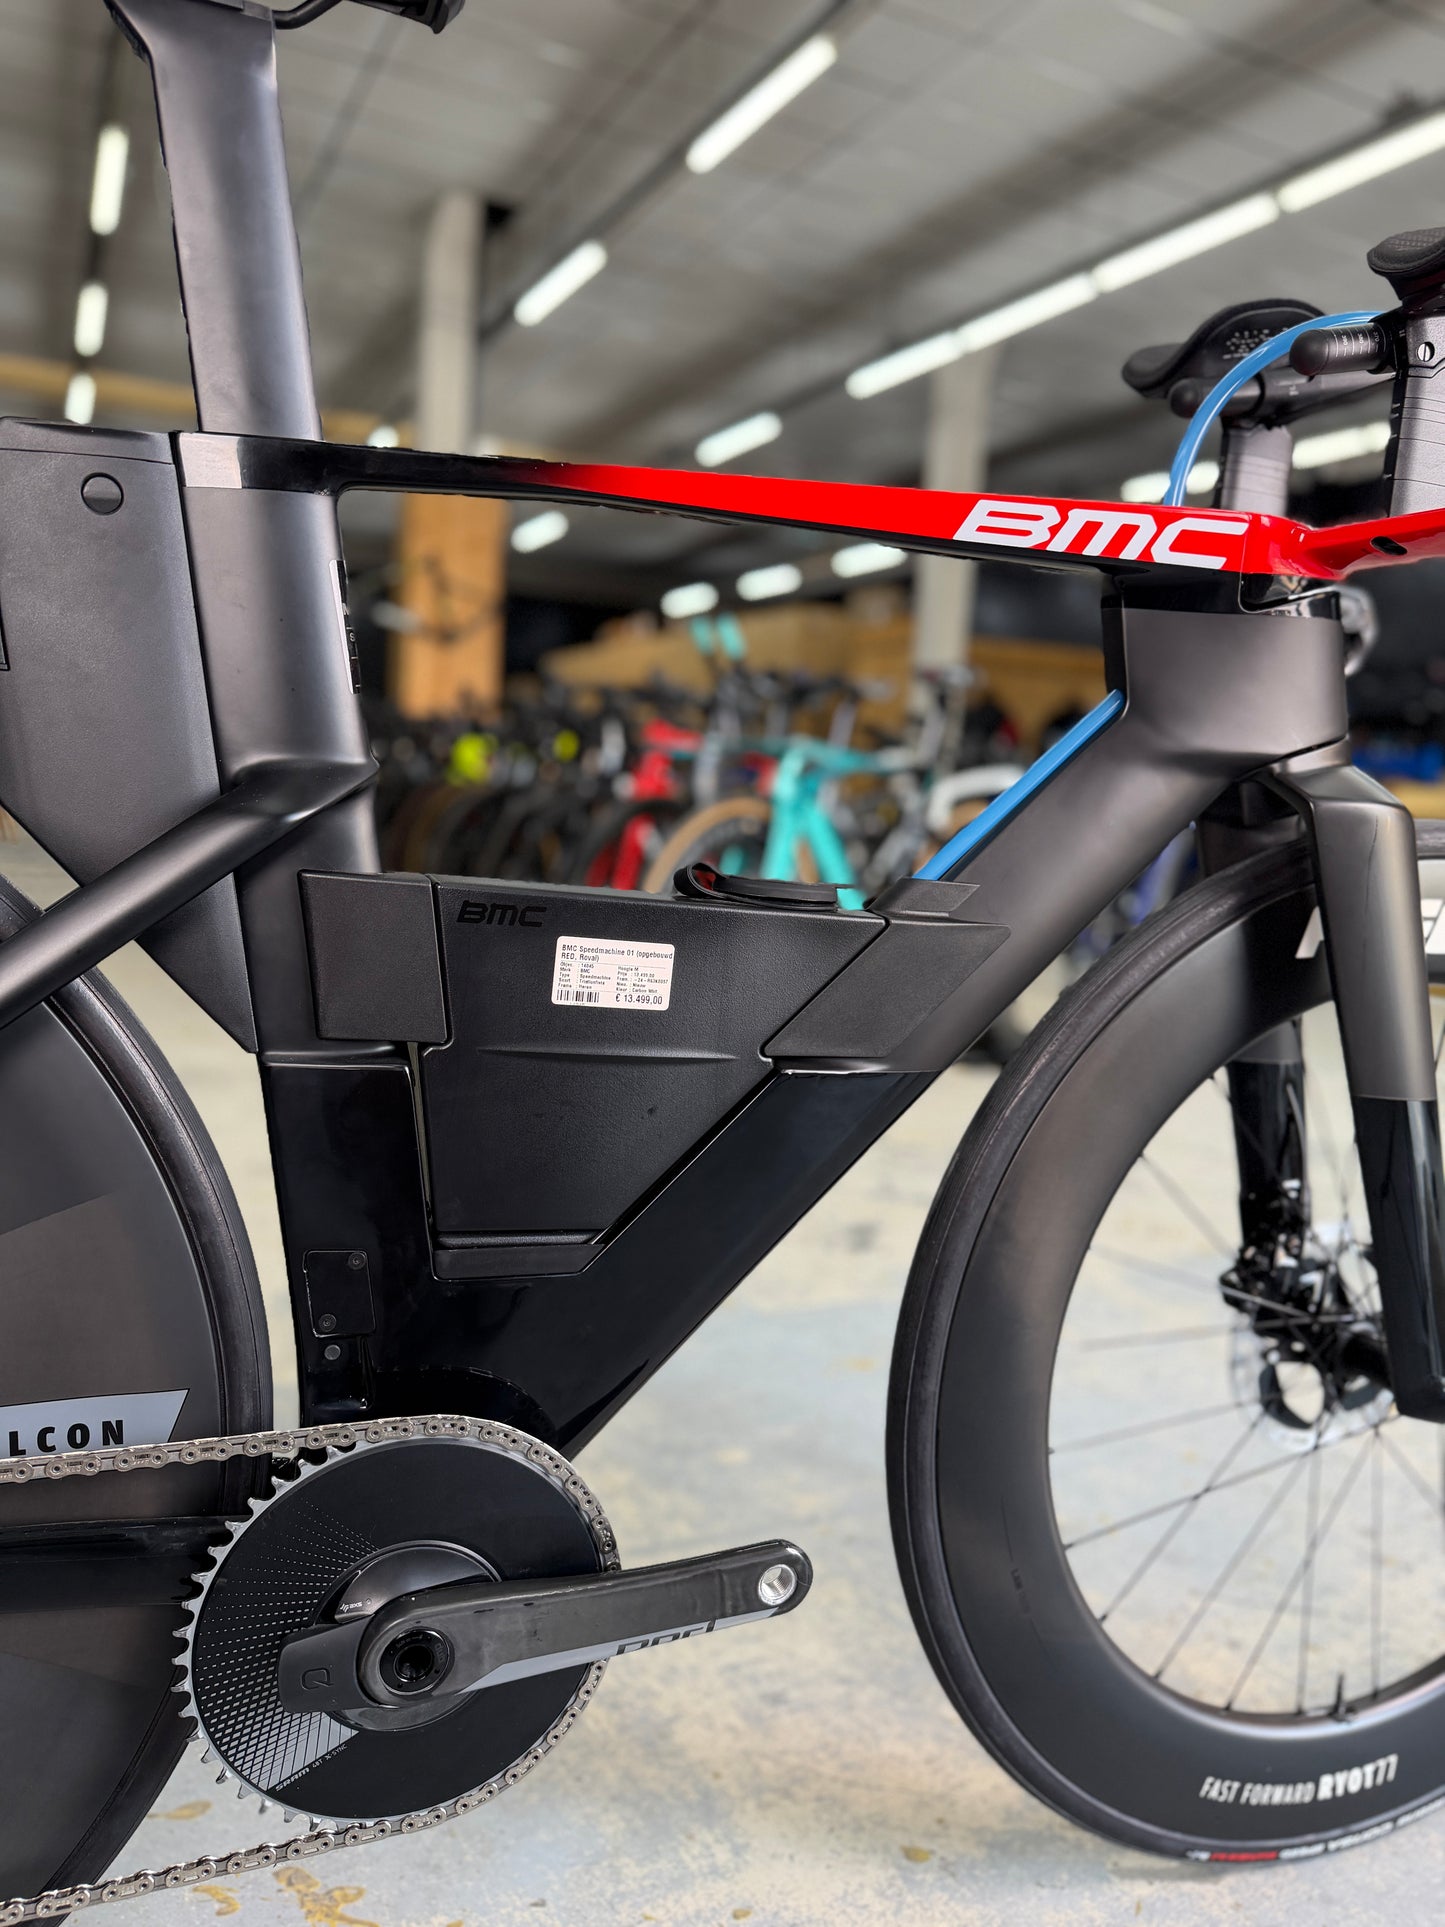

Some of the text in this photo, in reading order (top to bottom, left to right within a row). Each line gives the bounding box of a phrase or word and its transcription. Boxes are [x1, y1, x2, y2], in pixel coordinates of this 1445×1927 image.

[953, 499, 1249, 570] BMC
[456, 900, 547, 927] BMC
[561, 944, 577, 952] BMC
[579, 946, 625, 956] Speedmachine
[636, 950, 673, 959] (opgebouwd
[579, 954, 600, 962] Roval)
[615, 993, 663, 1004] € 13.499,00
[9, 1420, 124, 1457] LCON
[275, 1767, 310, 1792] SRAM
[1199, 1776, 1241, 1803] FAST
[1240, 1781, 1316, 1806] FORWARD
